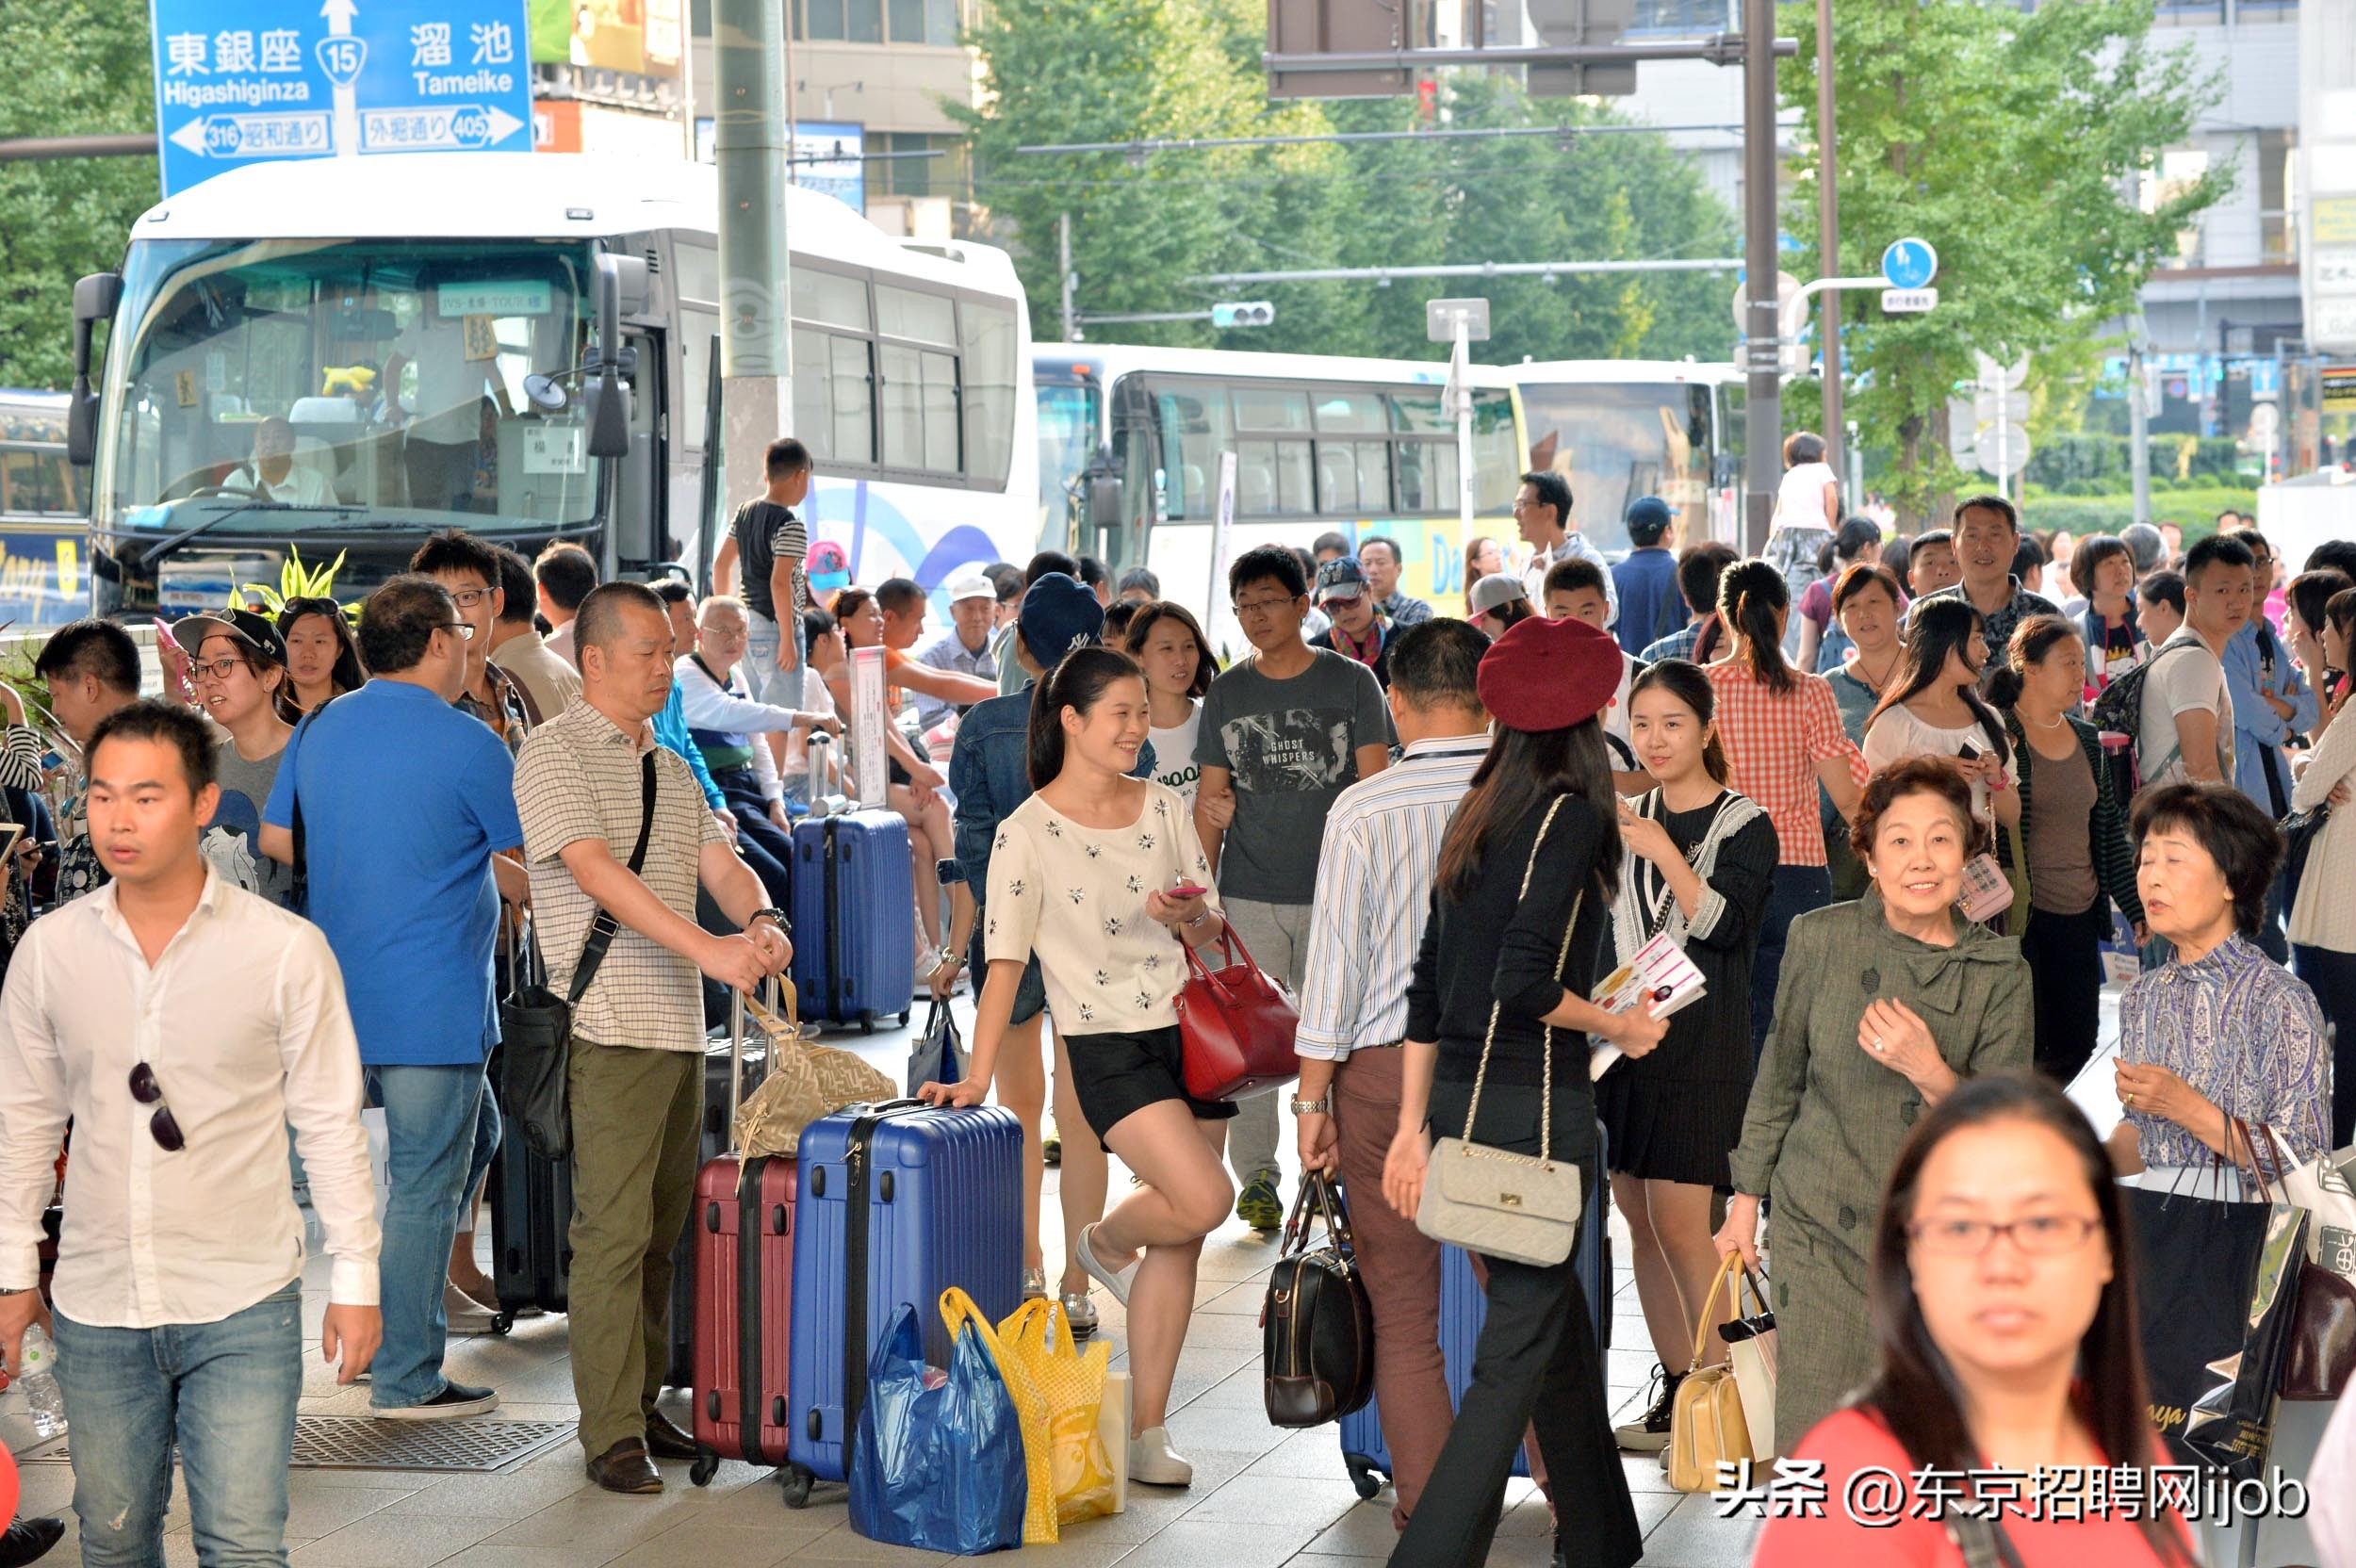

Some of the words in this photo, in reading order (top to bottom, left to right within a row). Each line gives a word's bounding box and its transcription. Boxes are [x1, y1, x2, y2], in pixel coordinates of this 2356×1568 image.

[167, 29, 302, 76] 東銀座
[327, 44, 356, 74] 15
[164, 81, 309, 108] Higashiginza
[413, 71, 513, 96] Tameike
[207, 126, 239, 149] 316
[243, 119, 322, 149] 昭和通り
[369, 113, 447, 141] 外堀通り
[453, 115, 486, 139] 405
[1262, 751, 1316, 765] WHISPERS
[1270, 739, 1303, 752] GHOST
